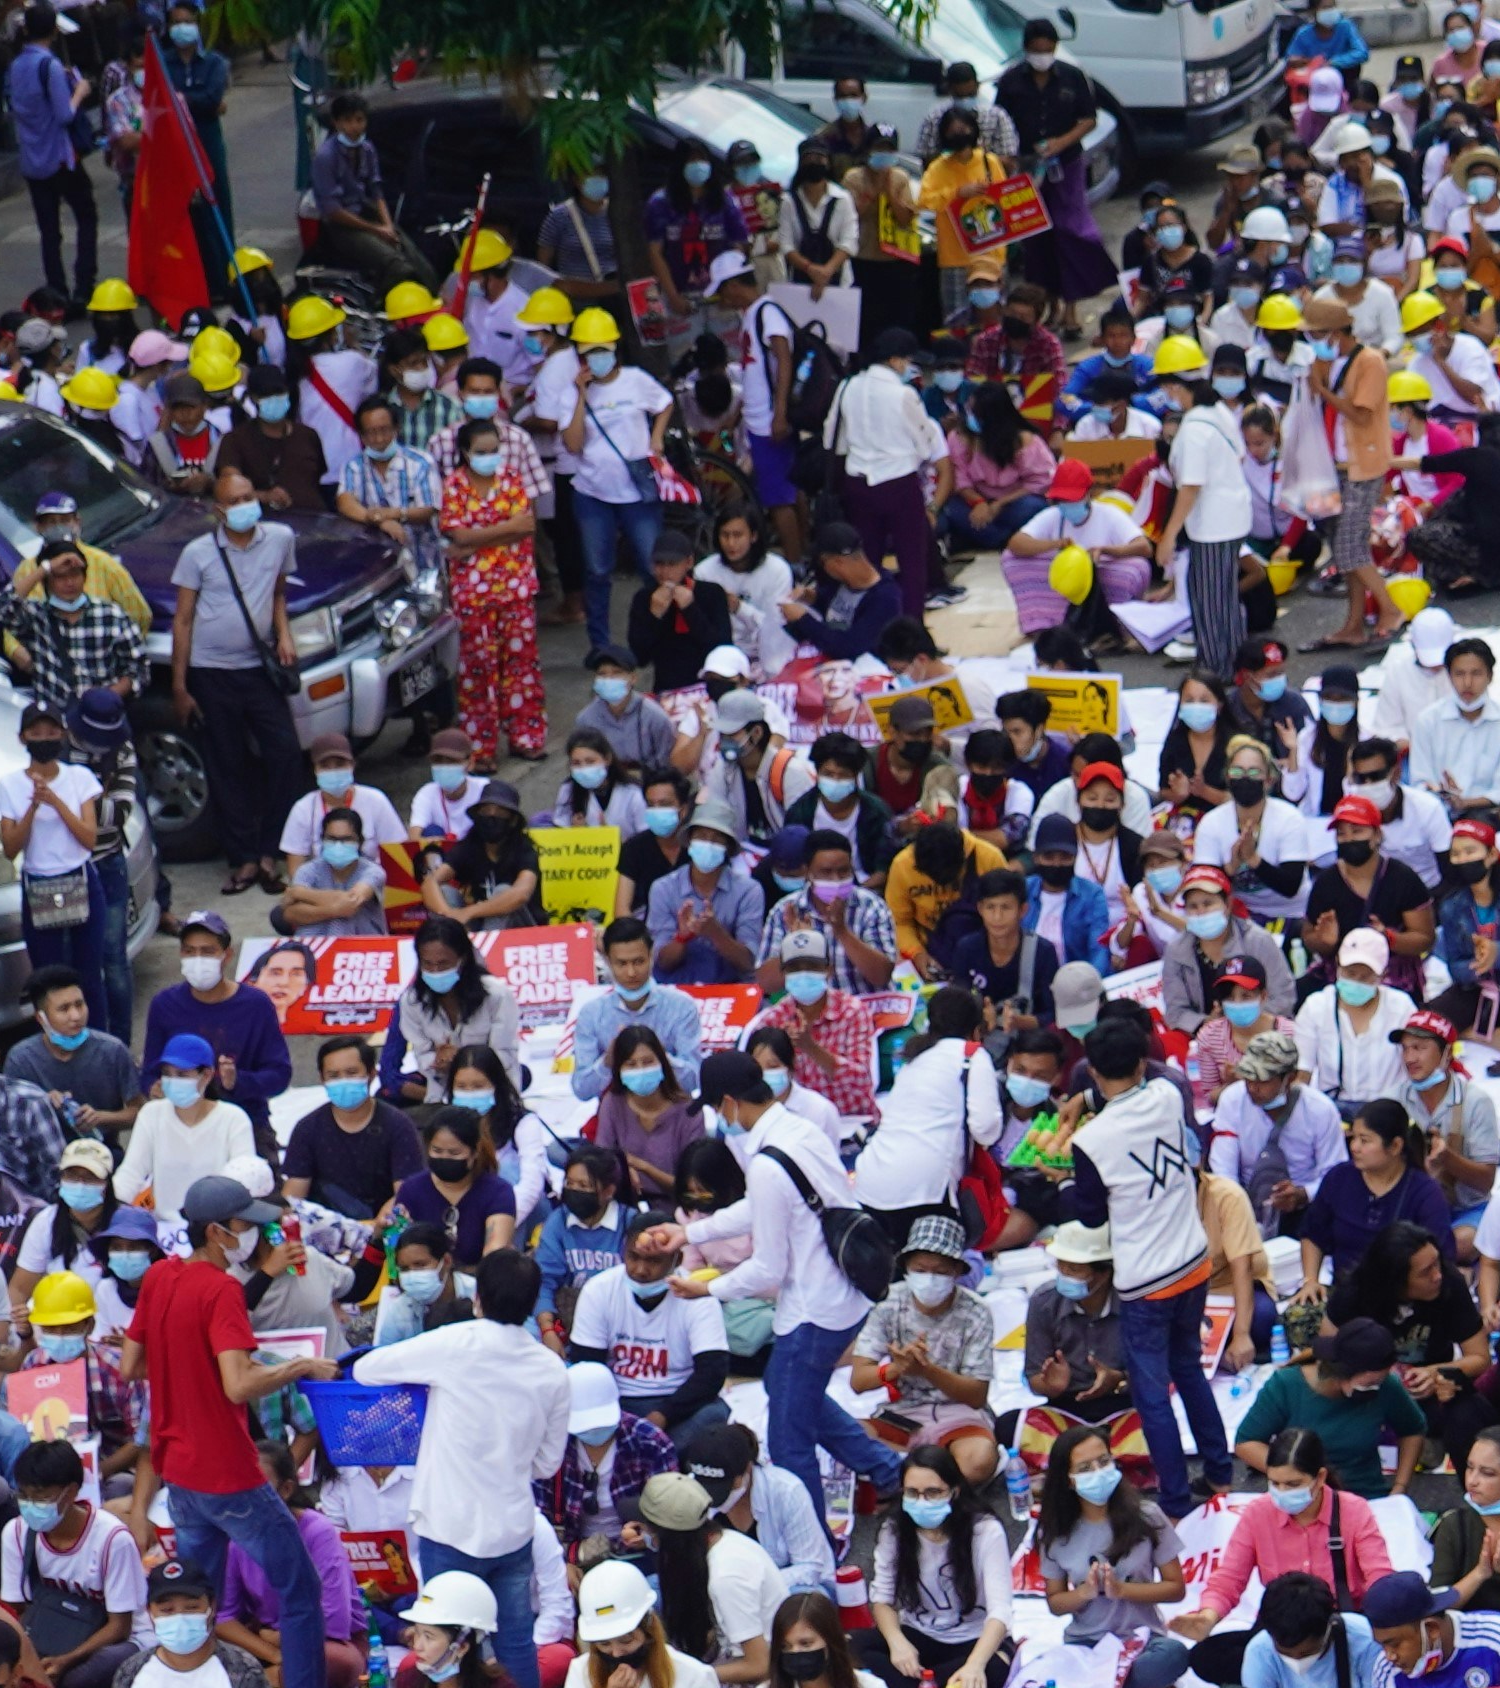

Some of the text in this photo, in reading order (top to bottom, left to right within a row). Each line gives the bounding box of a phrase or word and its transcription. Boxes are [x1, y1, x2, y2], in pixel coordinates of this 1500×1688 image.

[332, 951, 394, 973] FREE
[505, 943, 569, 967] FREE
[332, 969, 388, 988] OUR
[506, 962, 556, 986] OUR
[309, 982, 401, 1003] LEADER
[613, 1345, 668, 1381] CDM
